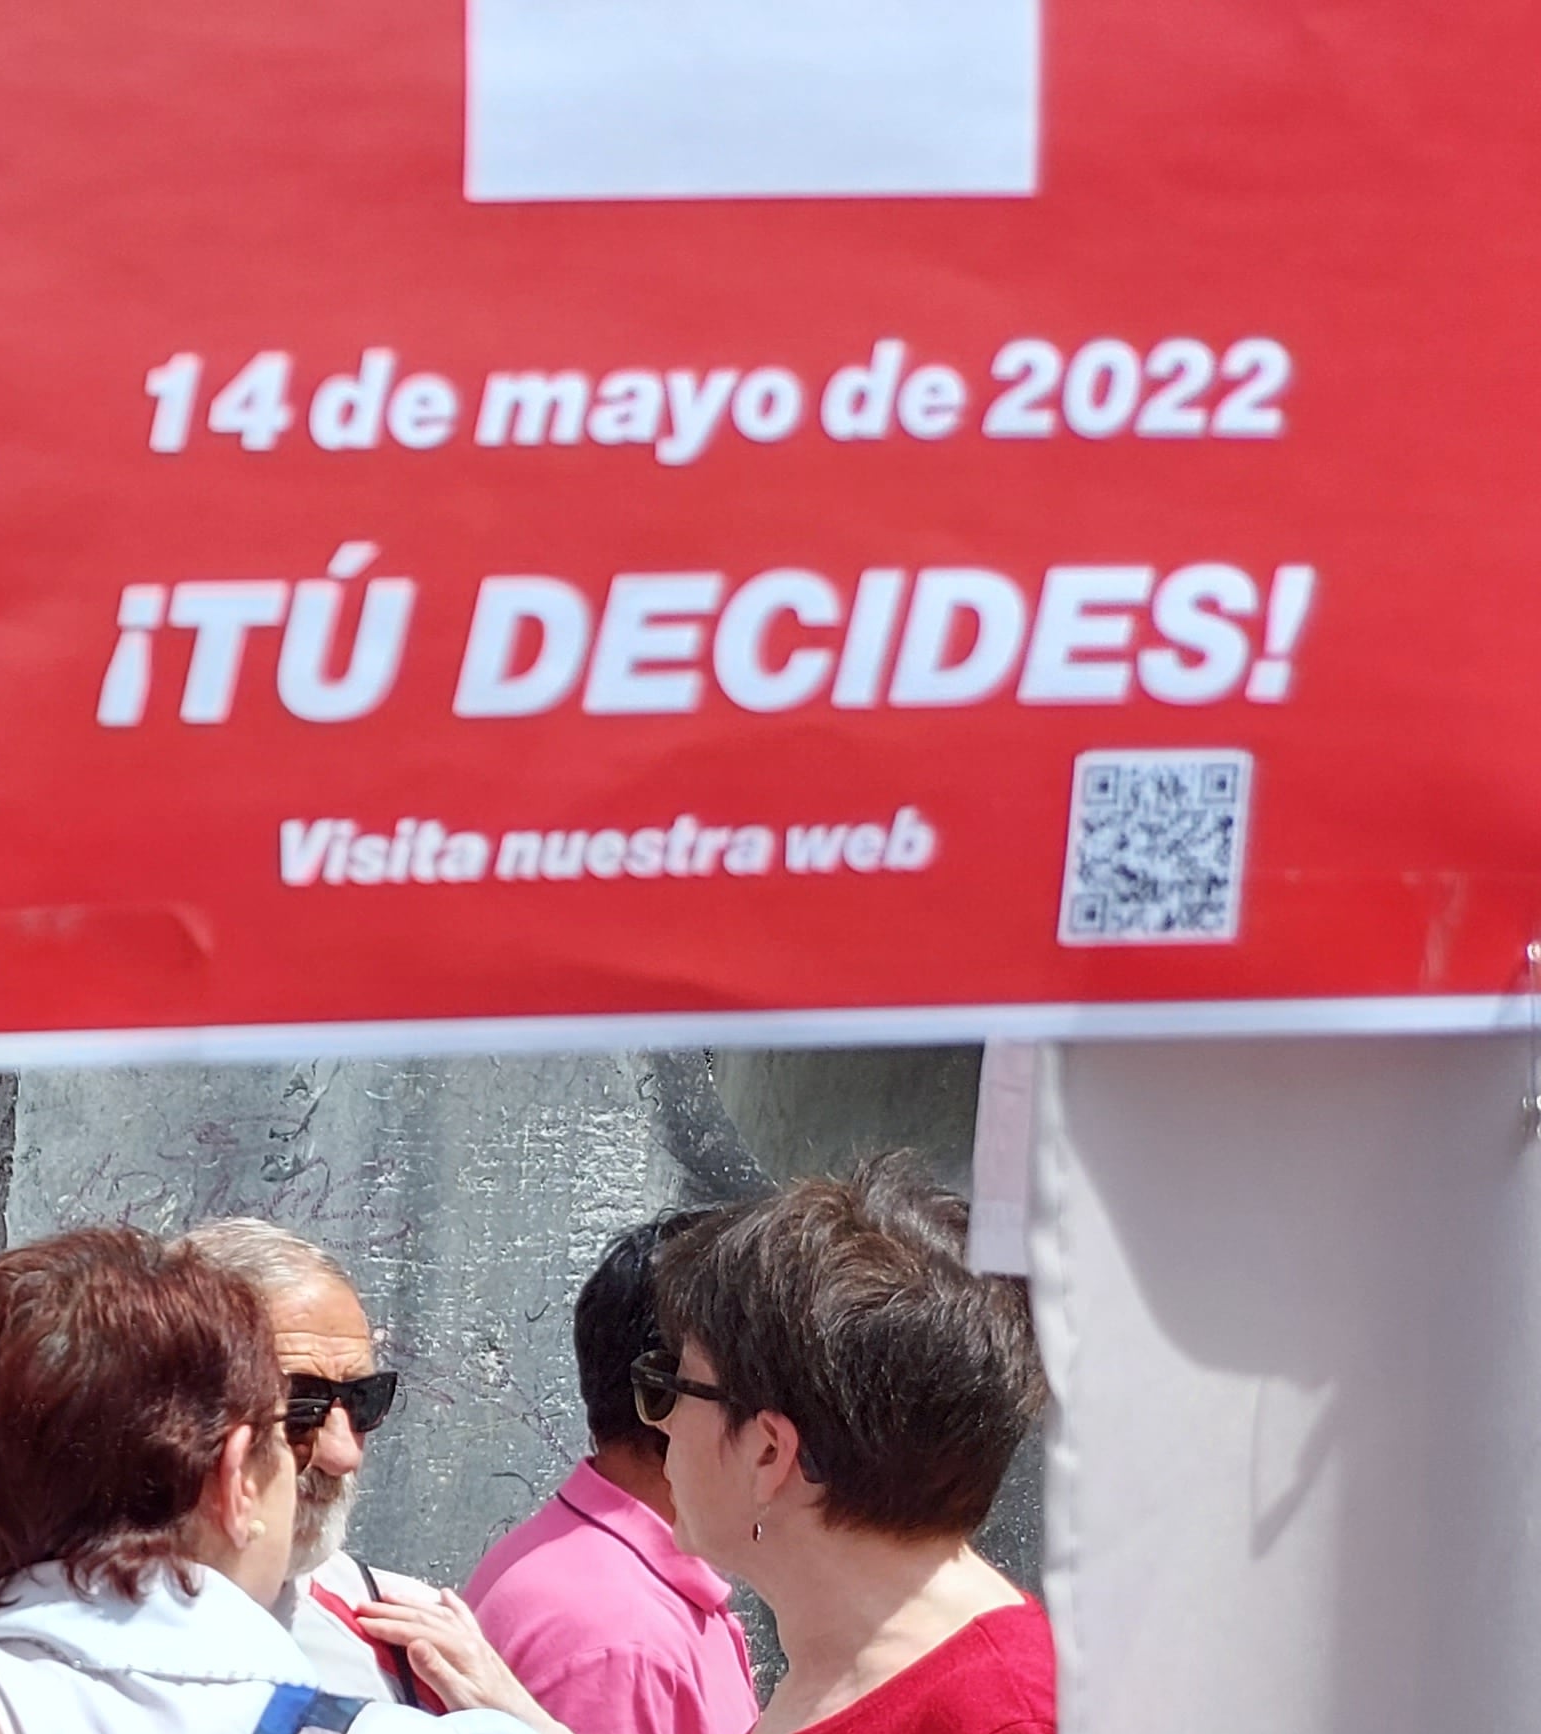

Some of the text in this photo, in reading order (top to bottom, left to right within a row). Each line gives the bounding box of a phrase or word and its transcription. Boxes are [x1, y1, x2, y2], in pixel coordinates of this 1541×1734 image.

[144, 338, 1291, 468] 14 de mayo de 2022
[97, 540, 1319, 730] ¡TÚ DECIDES!
[278, 806, 939, 889] Visita nuestra web
